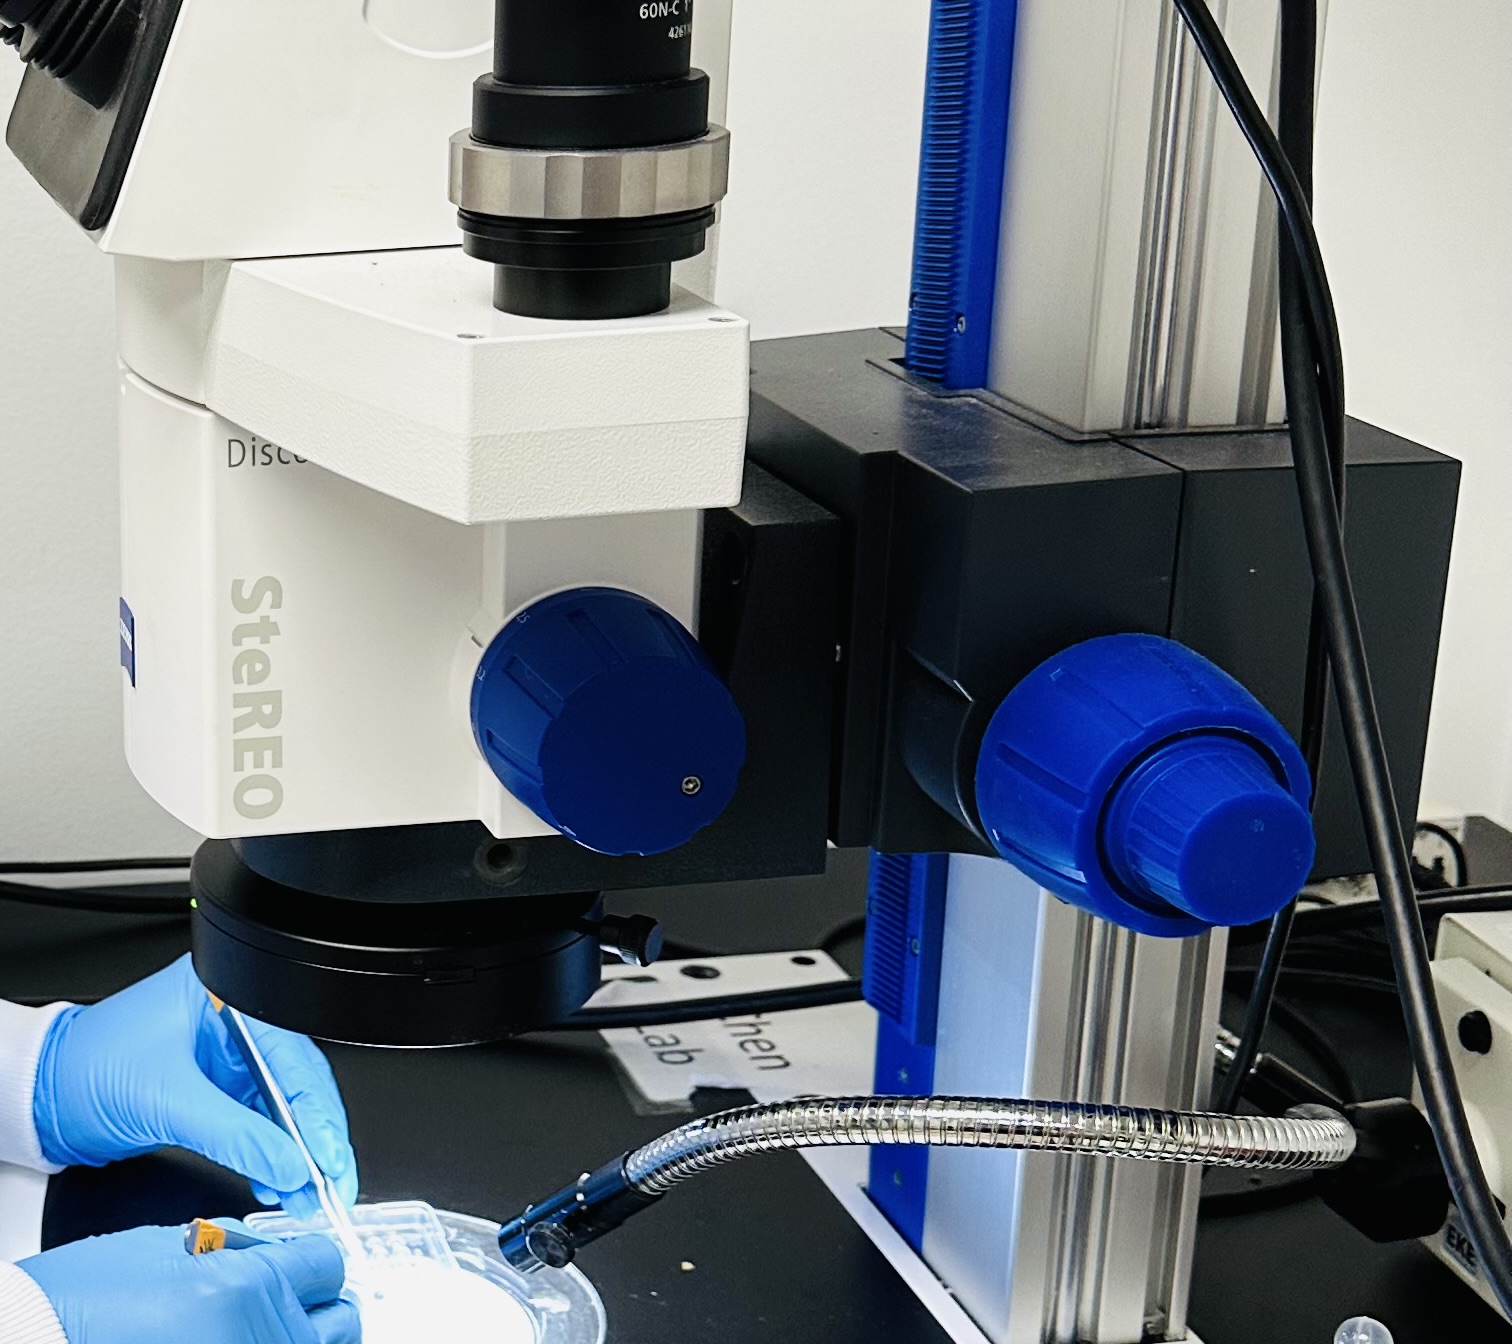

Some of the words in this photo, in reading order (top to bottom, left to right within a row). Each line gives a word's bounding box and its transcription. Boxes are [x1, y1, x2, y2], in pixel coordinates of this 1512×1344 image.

[639, 0, 680, 19] 60N-C
[230, 575, 284, 820] SteREO
[719, 1013, 792, 1071] hen
